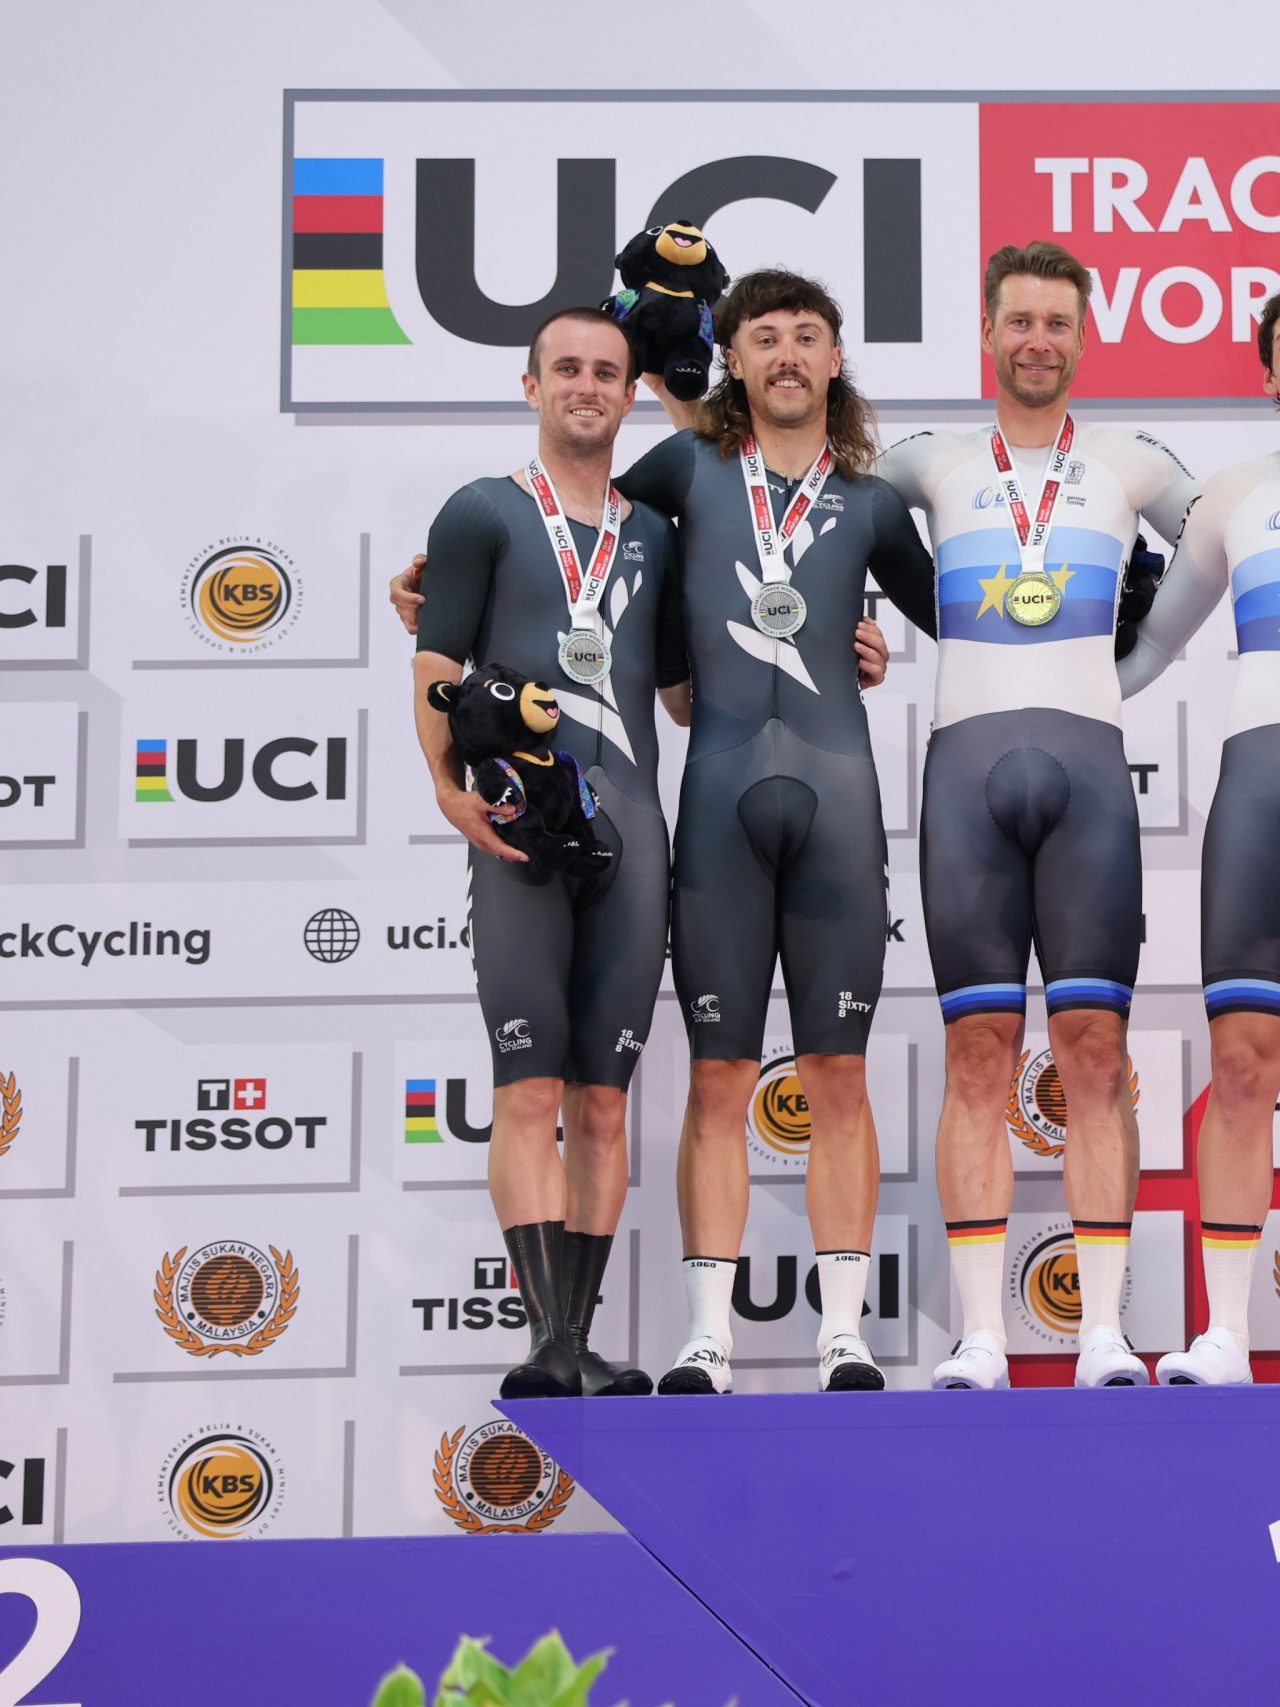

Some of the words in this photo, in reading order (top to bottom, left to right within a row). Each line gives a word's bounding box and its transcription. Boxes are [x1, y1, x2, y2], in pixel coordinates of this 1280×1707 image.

[747, 456, 758, 474] UCI
[1055, 452, 1066, 469] UCI
[811, 471, 822, 488] UCI
[1007, 484, 1018, 501] UCI
[220, 536, 250, 545] BELIA
[555, 529, 568, 549] UCI
[762, 531, 773, 551] UCI
[1034, 525, 1045, 543] UCI
[223, 584, 274, 606] KBS
[587, 579, 600, 598] UCI
[1022, 595, 1044, 604] UCI
[768, 605, 790, 616] UCI
[575, 652, 596, 662] UCI
[176, 736, 347, 802] UCI
[838, 991, 852, 1000] 18
[838, 1000, 872, 1013] SIXTY
[838, 1010, 846, 1018] 8
[621, 1029, 633, 1038] 18
[499, 1037, 532, 1049] CYCLING
[615, 1044, 622, 1052] 8
[1025, 1062, 1044, 1105] MAJLIS
[777, 1095, 809, 1116] KB
[135, 1116, 327, 1152] TISSOT
[180, 1258, 201, 1303] MAJLIS
[201, 1244, 246, 1260] SUKAN
[247, 1251, 274, 1300] NEGARA
[196, 1320, 257, 1338] MALAYSIA
[158, 1432, 194, 1502] KEMENTERIAN
[199, 1423, 231, 1433] BELIA
[248, 1429, 276, 1454] SUKAN
[459, 1438, 479, 1483] MAJLIS
[202, 1475, 255, 1498] KBS
[270, 1468, 286, 1519] MINISTRY
[475, 1500, 536, 1517] MALAYSIA
[0, 1557, 81, 1707] 2
